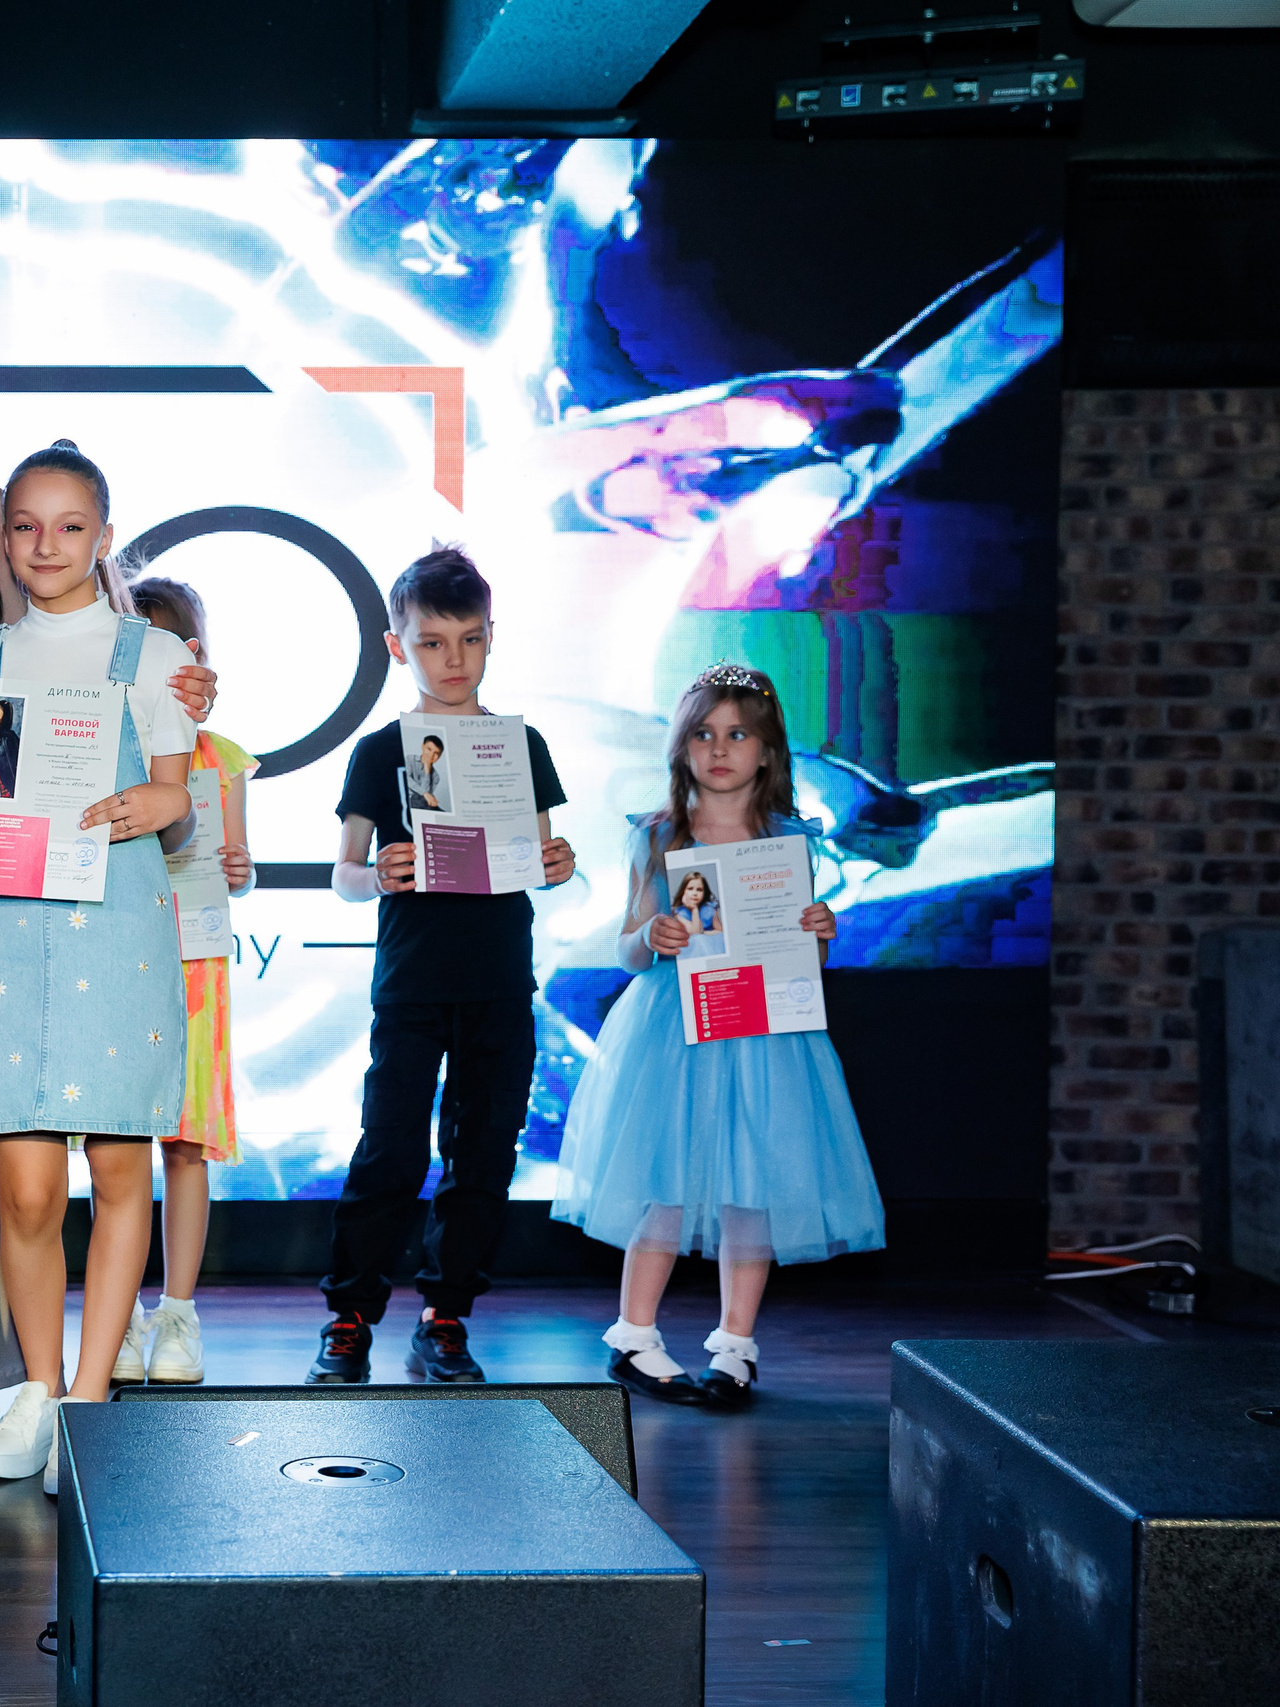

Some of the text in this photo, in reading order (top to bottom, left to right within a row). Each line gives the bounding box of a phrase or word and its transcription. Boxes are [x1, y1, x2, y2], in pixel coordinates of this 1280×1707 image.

[47, 687, 101, 699] ДИПЛОМ
[50, 718, 100, 729] ПОПОВОЙ
[459, 720, 505, 728] DIPLOMA
[54, 728, 97, 739] ВАРВАРЕ
[735, 842, 785, 857] ДИПЛОМ
